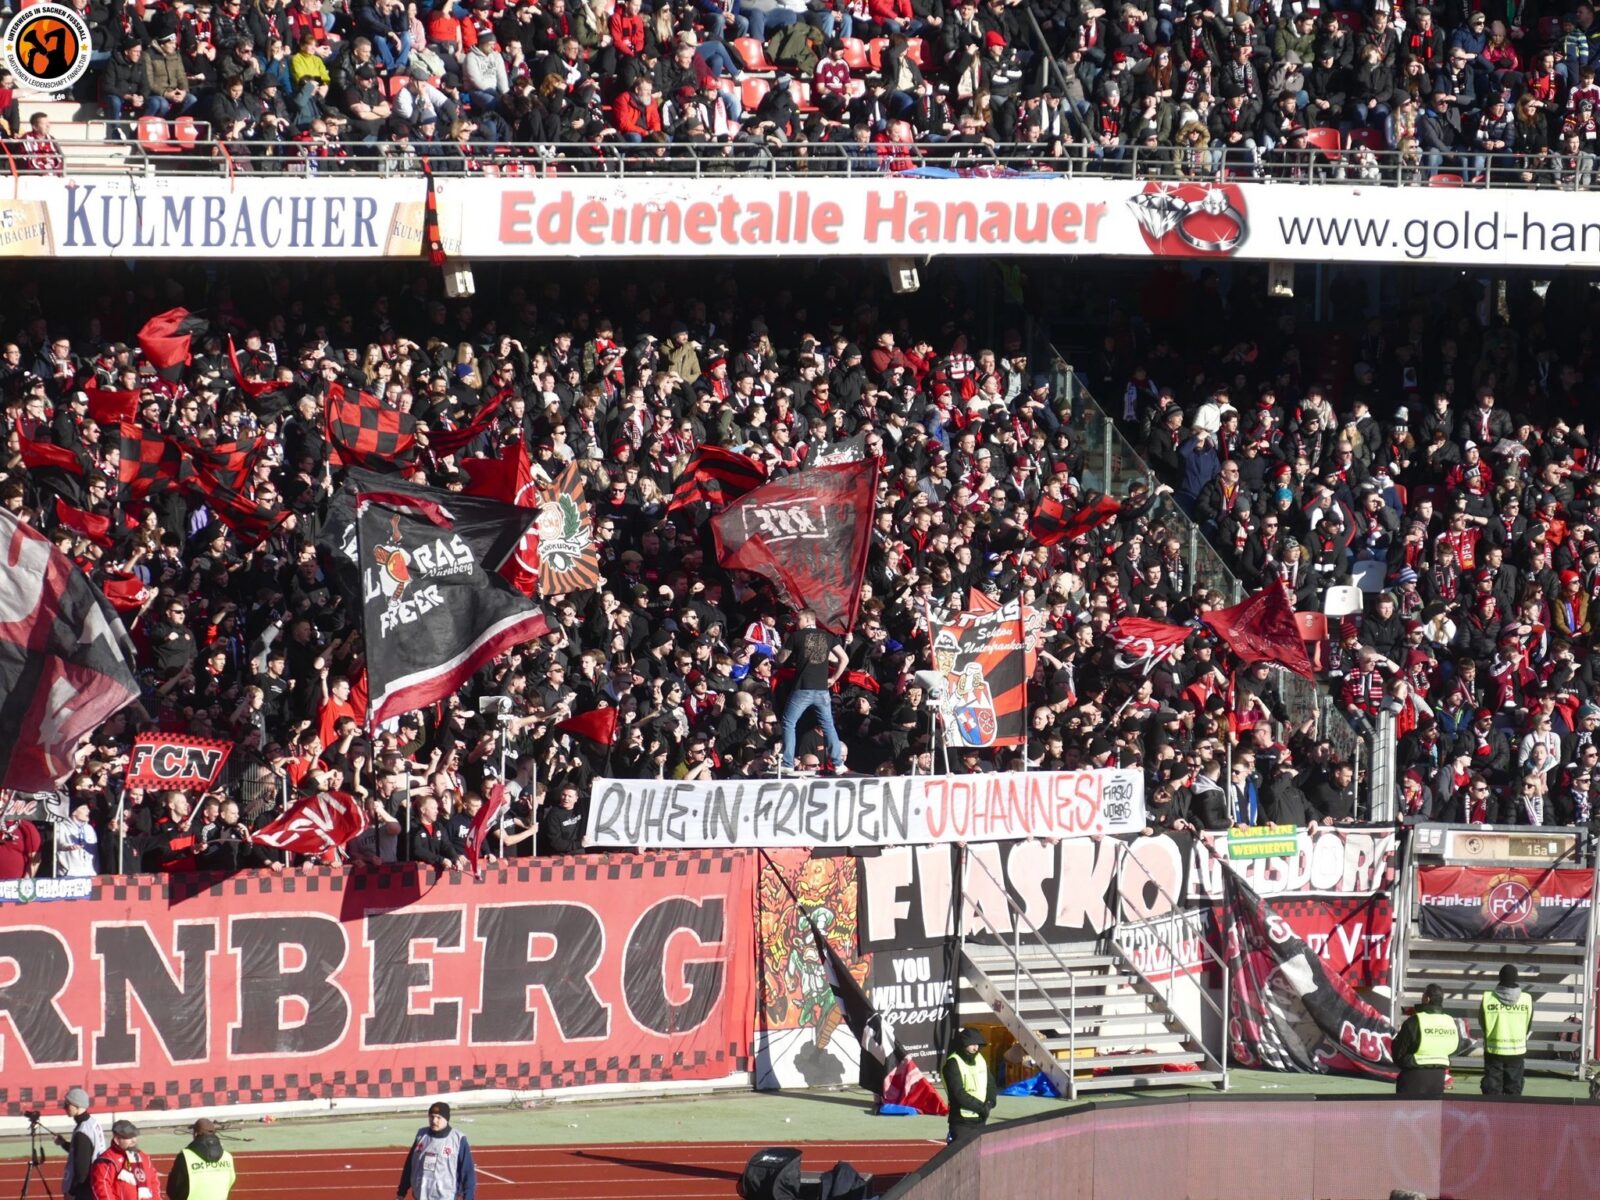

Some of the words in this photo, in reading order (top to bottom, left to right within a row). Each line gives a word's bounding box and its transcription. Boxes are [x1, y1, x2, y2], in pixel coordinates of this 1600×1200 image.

[63, 184, 379, 248] KULMBACHER
[864, 190, 1106, 244] Hanauer
[420, 563, 474, 580] Nürnberg
[129, 745, 223, 780] FCN
[594, 782, 696, 844] RUHE
[703, 785, 745, 844] IN
[754, 779, 912, 843] FRIEDEN
[1527, 844, 1548, 856] 15a
[868, 836, 1184, 940] FIASKO
[1493, 900, 1527, 914] FCN
[892, 956, 931, 983] YOU
[872, 984, 915, 1011] WILL
[917, 980, 955, 1007] LIVE
[1500, 1003, 1528, 1011] POWER
[1434, 1028, 1455, 1036] POWER
